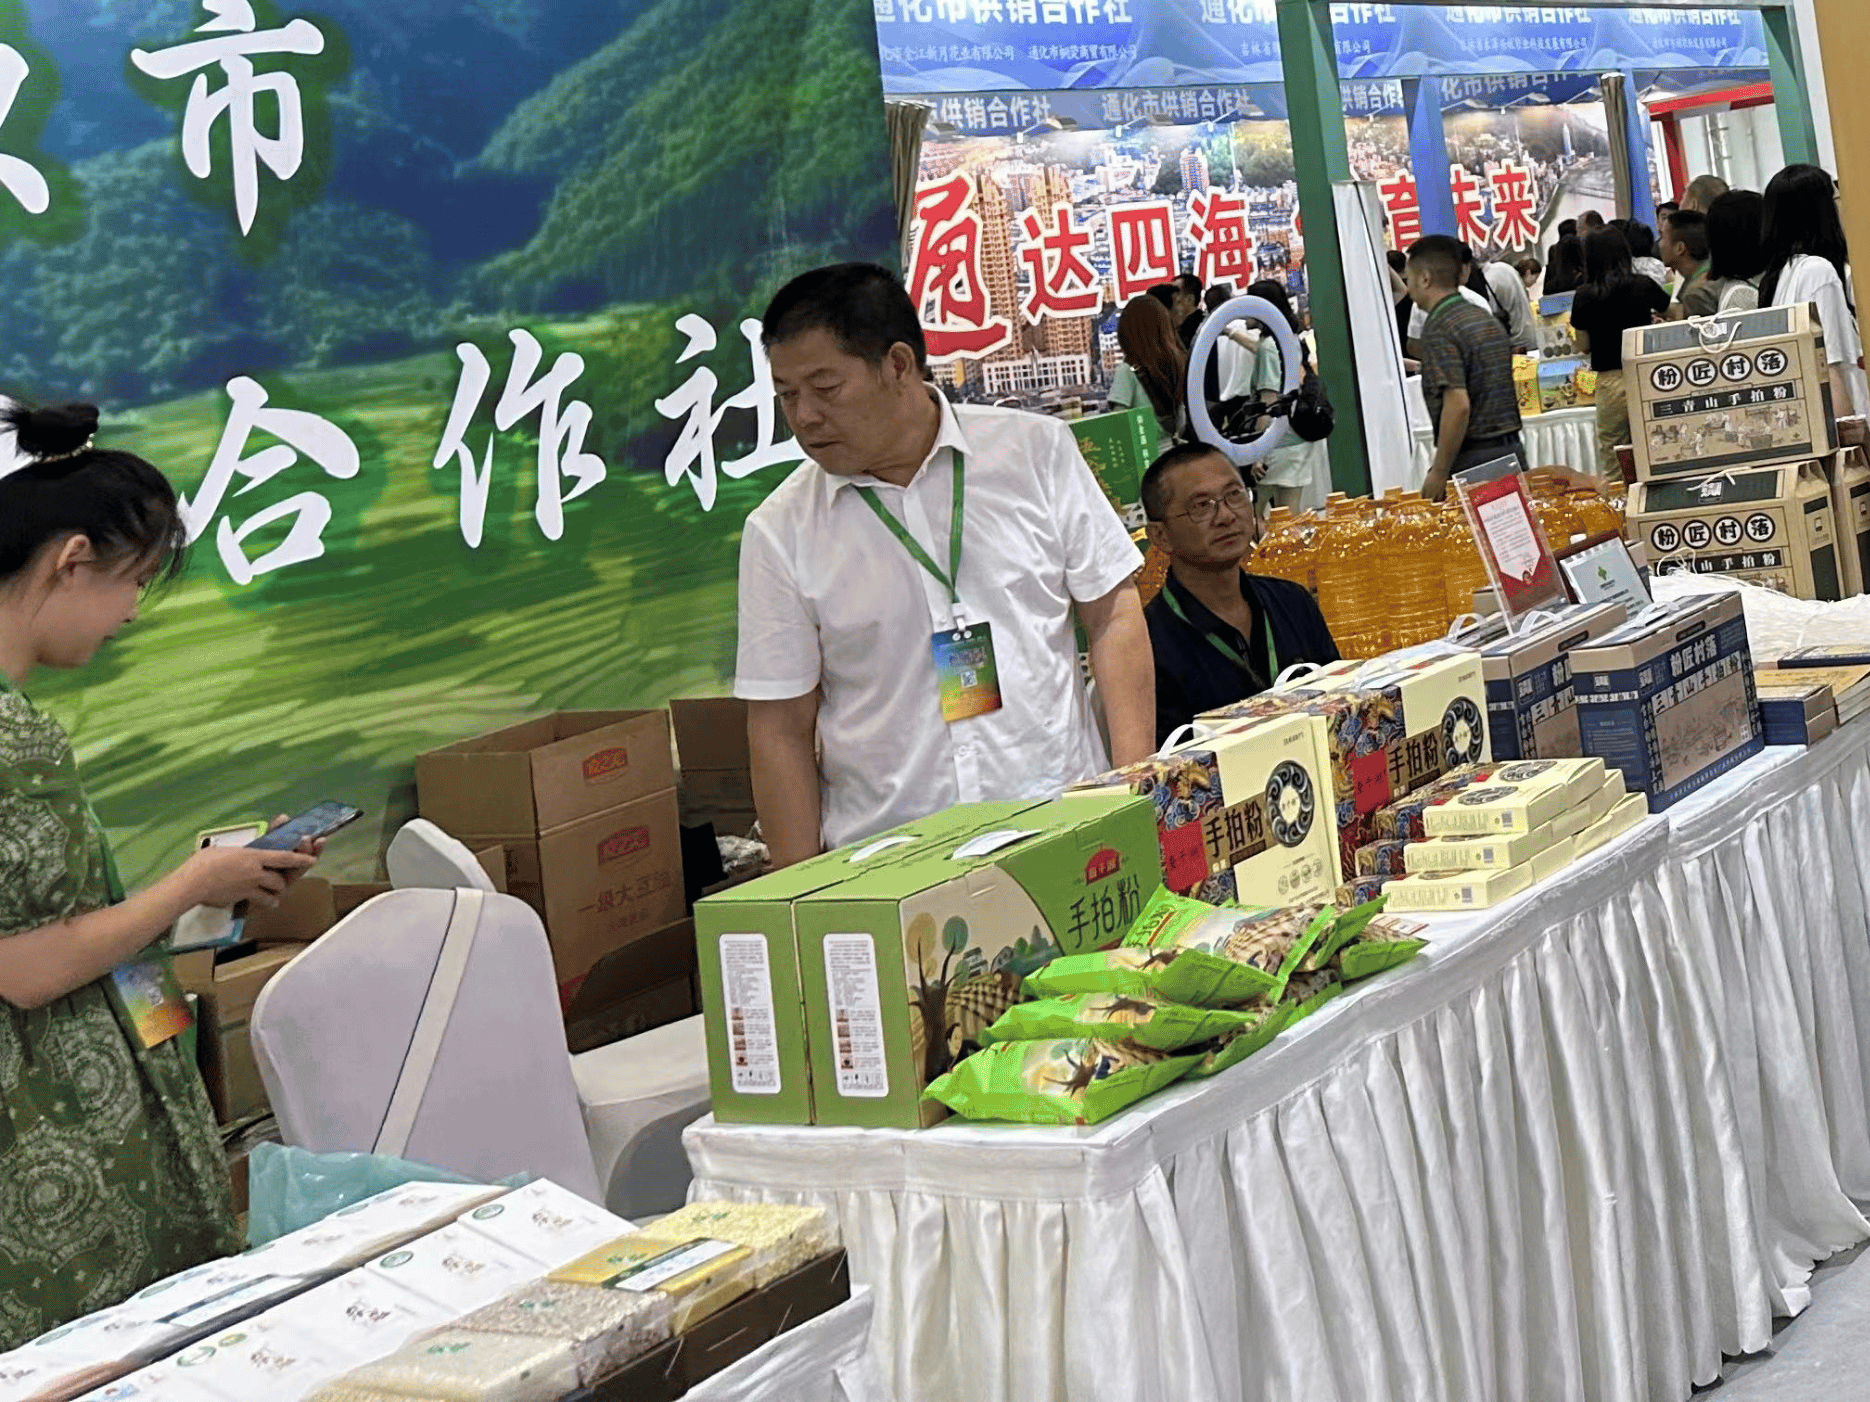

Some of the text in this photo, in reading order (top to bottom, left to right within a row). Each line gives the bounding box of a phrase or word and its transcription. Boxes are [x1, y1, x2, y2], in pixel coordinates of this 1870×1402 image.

[1654, 350, 1785, 389] 粉匠村落
[1658, 386, 1788, 416] 三青山手拍粉
[1655, 516, 1771, 548] 粉匠村落
[1387, 731, 1440, 784] 手拍粉
[1204, 800, 1265, 859] 手拍粉
[1067, 874, 1141, 950] 手拍粉
